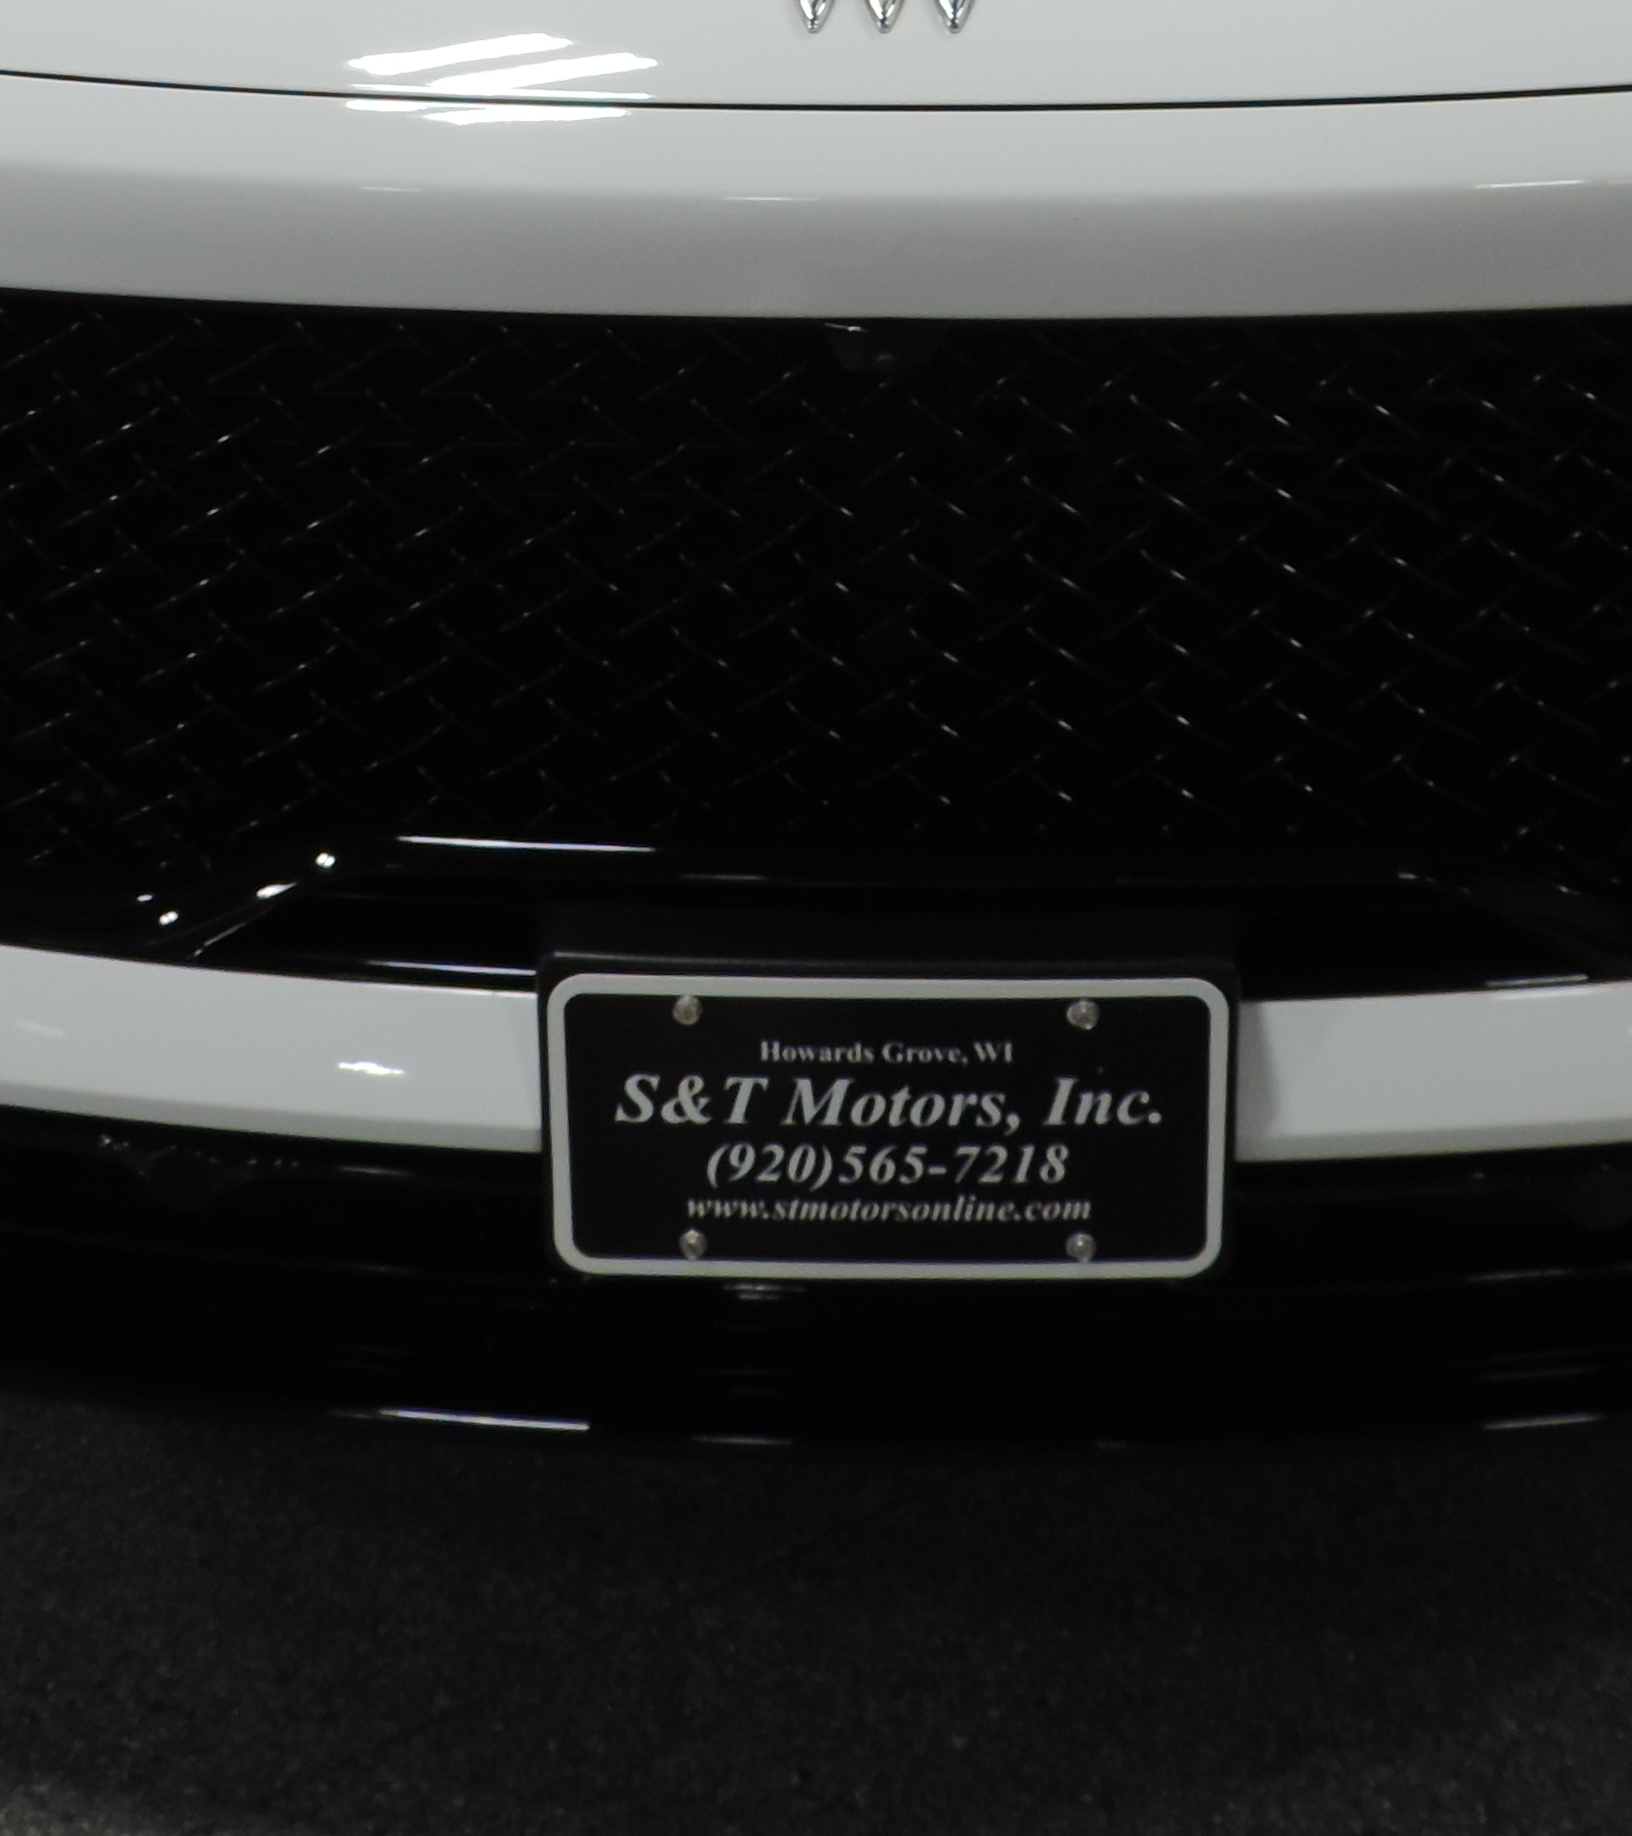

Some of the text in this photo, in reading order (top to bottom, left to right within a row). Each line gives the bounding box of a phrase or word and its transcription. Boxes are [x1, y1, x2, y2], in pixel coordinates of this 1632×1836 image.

[760, 1040, 1014, 1065] Howards Grove, WI
[614, 1073, 1163, 1134] S&T Motors, Inc.
[706, 1143, 1070, 1190] (920)565-7218
[686, 1195, 1091, 1222] www.stmotorsonline.com
